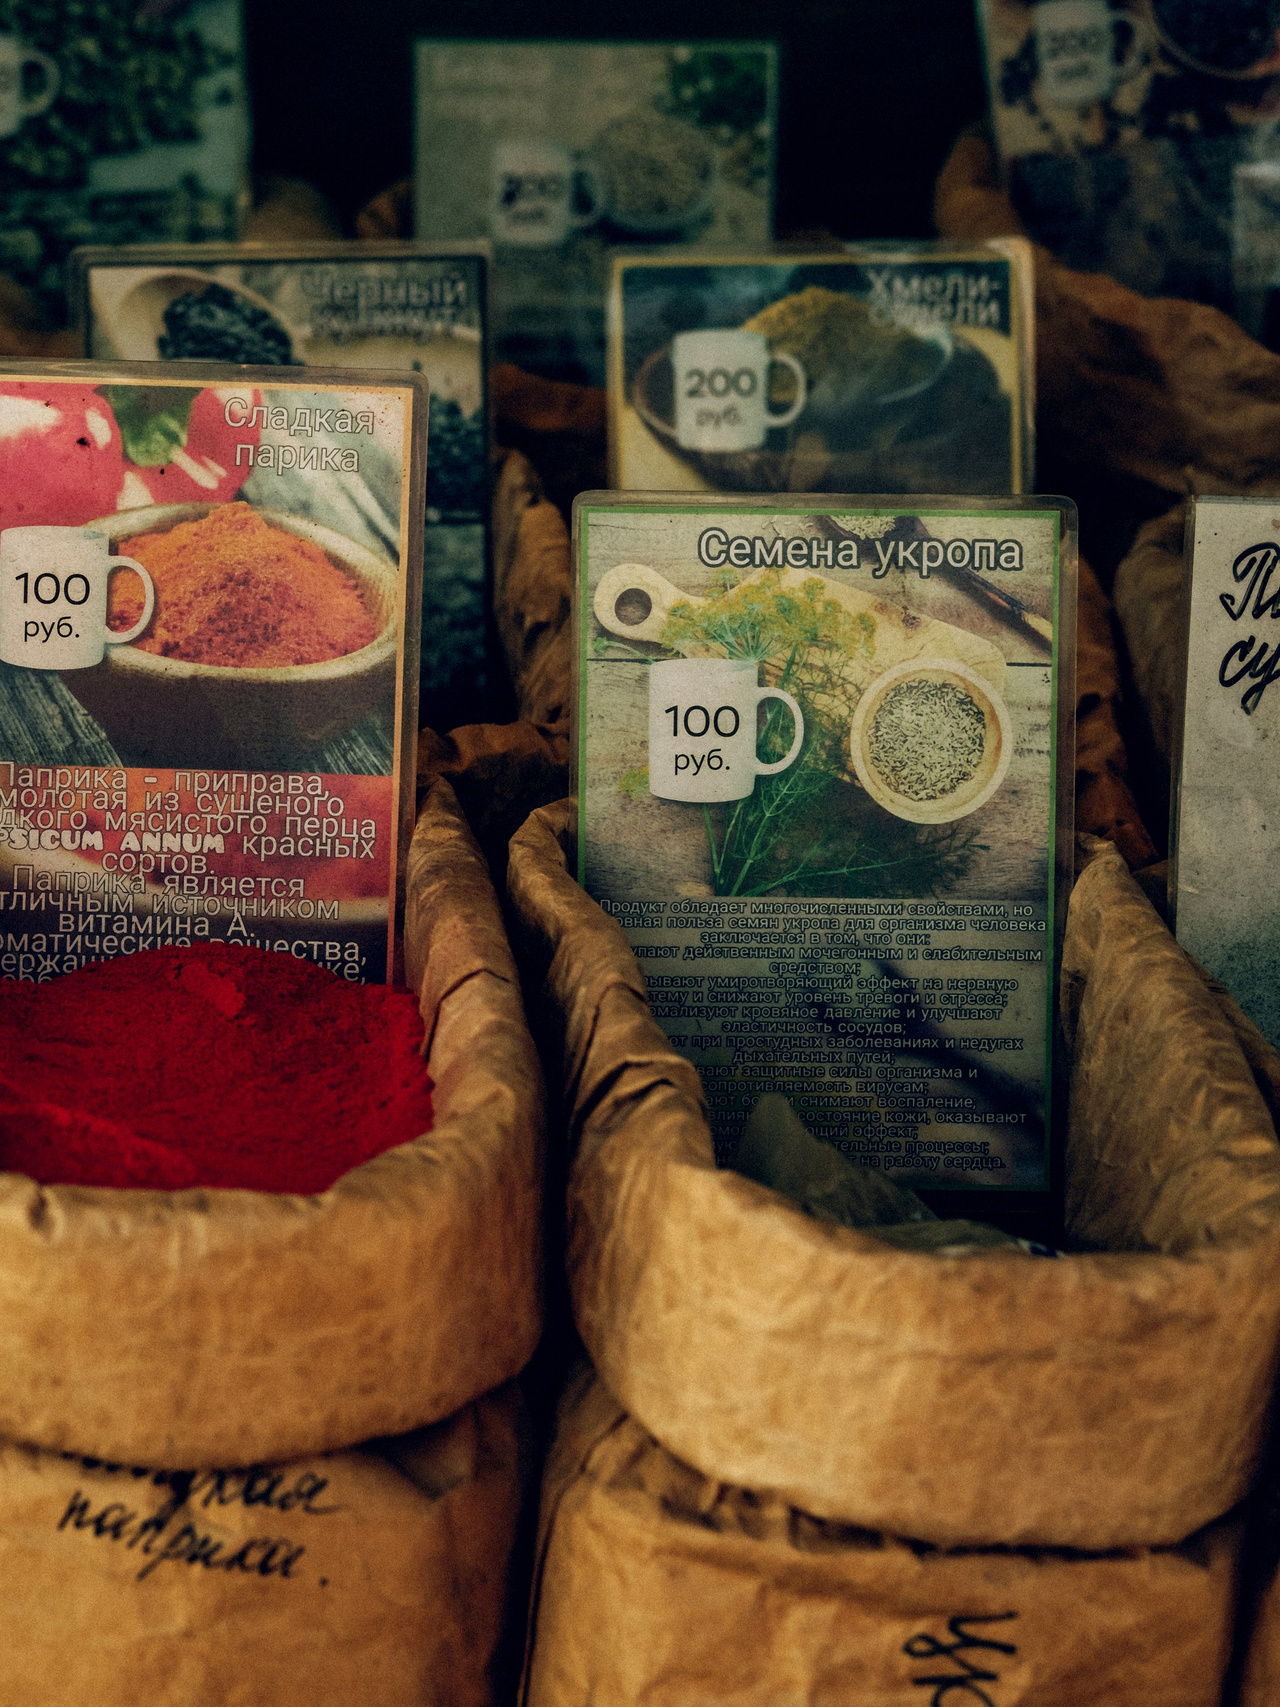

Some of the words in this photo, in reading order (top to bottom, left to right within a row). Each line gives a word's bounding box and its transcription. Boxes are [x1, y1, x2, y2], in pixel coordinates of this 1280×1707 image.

[686, 367, 757, 399] 200
[224, 396, 375, 437] Сладкая
[235, 443, 360, 476] парика
[698, 527, 861, 569] Семена
[873, 537, 1024, 579] укропа
[15, 572, 91, 605] 100
[24, 616, 80, 643] руб.
[665, 705, 740, 737] 100
[675, 748, 731, 776] руб.
[175, 771, 330, 800] приправа,
[145, 791, 179, 812] из
[196, 793, 345, 819] сушеного
[105, 811, 268, 834] мясистого
[285, 815, 377, 844] перца
[243, 834, 375, 861] красных
[102, 853, 216, 877] сортов.
[13, 864, 145, 898] Паприка
[164, 875, 305, 898] является
[152, 894, 340, 919] источником
[600, 899, 666, 915] Продукт
[670, 899, 747, 915] обладает
[751, 902, 903, 915] многочисленными
[907, 903, 1008, 917] свойствами,
[1013, 906, 1033, 916] но
[59, 913, 210, 936] витамина
[617, 917, 662, 928] овная
[667, 917, 723, 928] польза
[728, 918, 779, 929] семян
[783, 918, 840, 931] укропа
[844, 919, 874, 930] для
[879, 919, 966, 932] организма
[971, 920, 1046, 931] человека
[700, 932, 806, 944] заключается
[810, 933, 820, 943] в
[825, 933, 859, 945] том,
[864, 934, 891, 945] что
[896, 934, 930, 945] они:
[683, 945, 794, 960] действенным
[799, 948, 903, 959] мочегонным
[907, 949, 918, 960] и
[922, 947, 1042, 961] слабительным
[769, 962, 861, 976] средством;
[709, 976, 853, 990] умиротворяющий
[857, 976, 919, 990] эффект
[923, 979, 943, 990] на
[948, 979, 1018, 992] нервную
[693, 992, 703, 1002] и
[708, 991, 782, 1004] снижают
[786, 992, 851, 1005] уровень
[857, 993, 920, 1006] тревоги
[925, 993, 935, 1004] и
[939, 994, 1008, 1006] стресса;
[742, 1006, 818, 1020] кровяное
[823, 1008, 901, 1019] давление
[906, 1008, 916, 1019] и
[921, 1008, 1003, 1023] улучшают
[722, 1020, 832, 1033] эластичность
[838, 1022, 906, 1035] сосудов;
[692, 1036, 721, 1050] при
[725, 1036, 822, 1050] простудных
[827, 1036, 939, 1049] заболеваниях
[945, 1038, 955, 1048] и
[960, 1038, 1023, 1051] недугах
[732, 1051, 842, 1064] дыхательных
[847, 1051, 896, 1066] путей;
[742, 1066, 825, 1078] защитные
[829, 1066, 871, 1078] силы
[876, 1067, 963, 1080] организма
[968, 1068, 978, 1078] и
[856, 1082, 929, 1095] вирусам;
[800, 1095, 873, 1108] снимают
[877, 1097, 976, 1109] воспаление,
[797, 1111, 880, 1122] состояние
[885, 1112, 931, 1124] кожи,
[935, 1112, 1027, 1123] оказывают
[853, 1124, 918, 1139] эффект;
[905, 1141, 989, 1155] процессы;
[860, 1156, 880, 1167] на
[884, 1154, 939, 1170] работу
[944, 1155, 1006, 1170] сердца.
